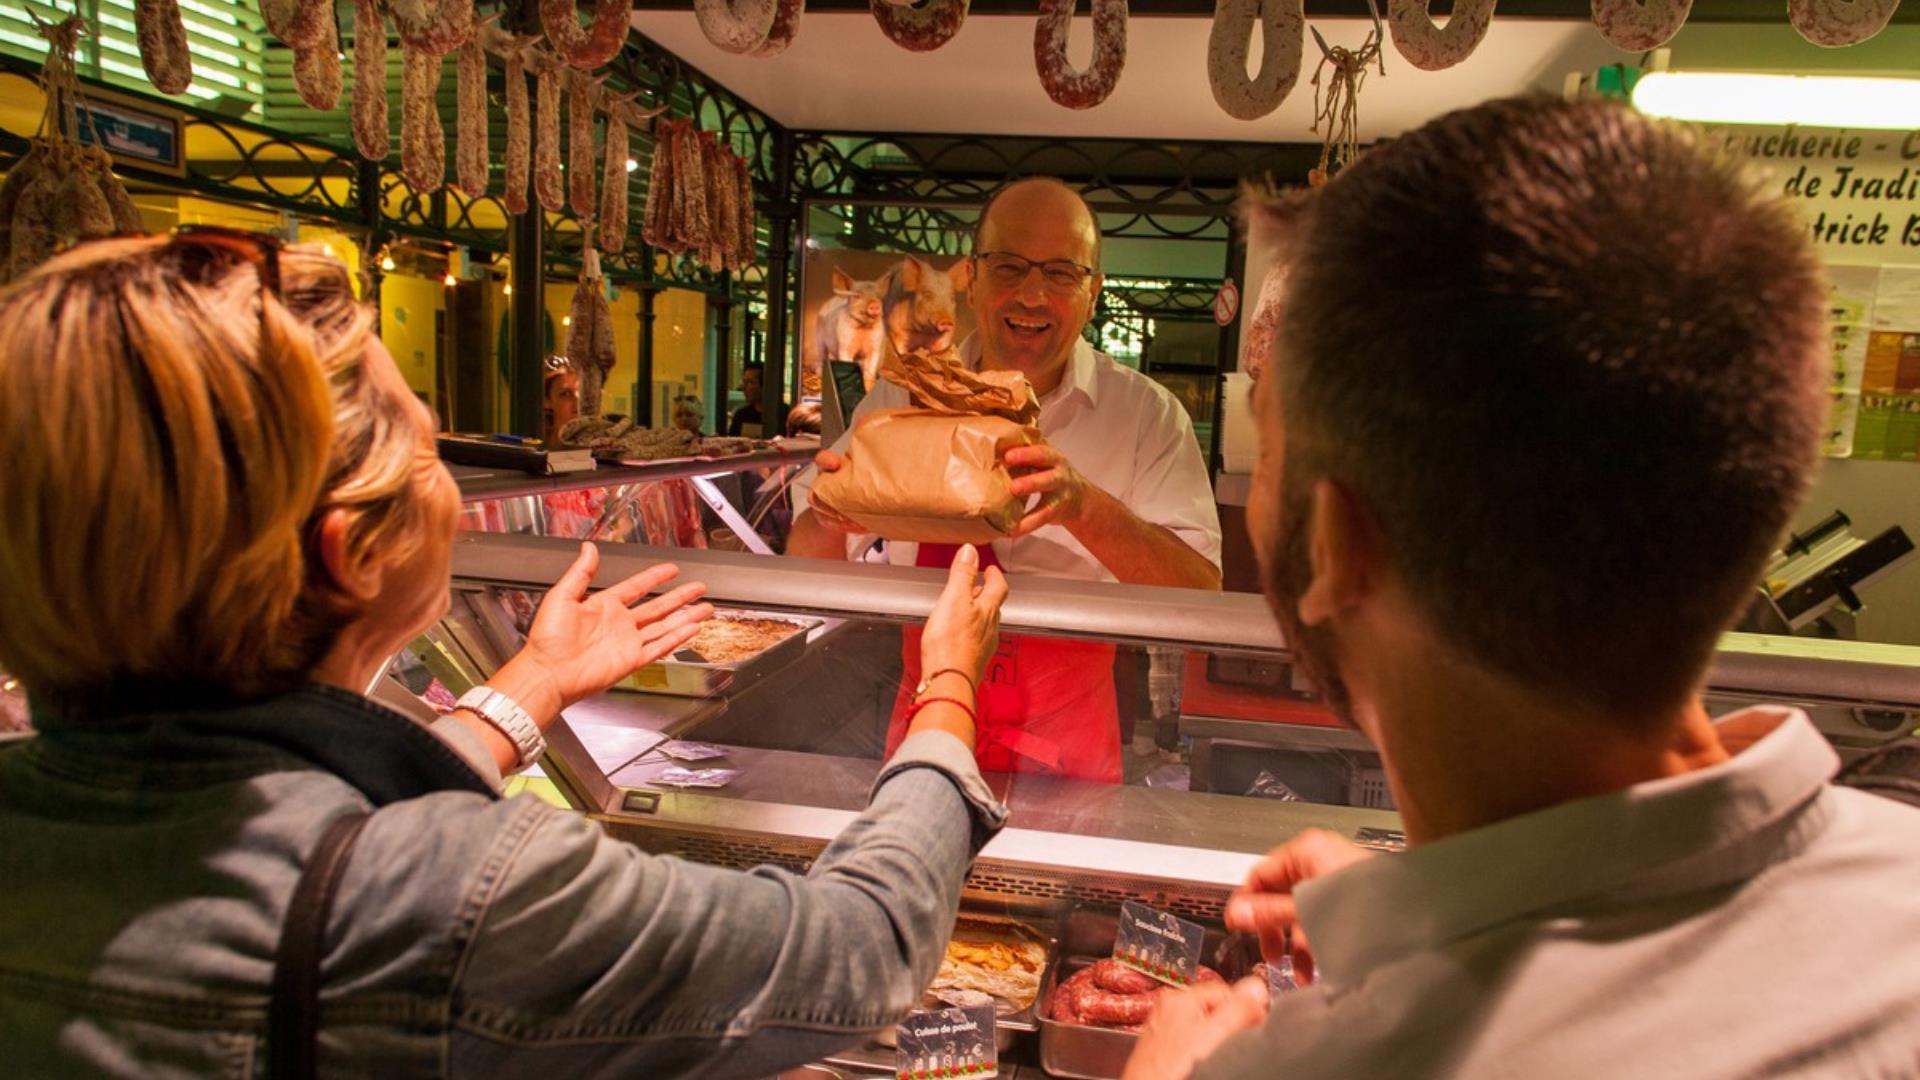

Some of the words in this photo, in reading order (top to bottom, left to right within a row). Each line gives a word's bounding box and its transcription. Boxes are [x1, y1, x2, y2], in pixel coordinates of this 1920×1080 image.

[1724, 124, 1862, 158] ucherie
[1784, 166, 1822, 198] de
[1830, 166, 1920, 200] Tradi
[1812, 212, 1890, 245] trick
